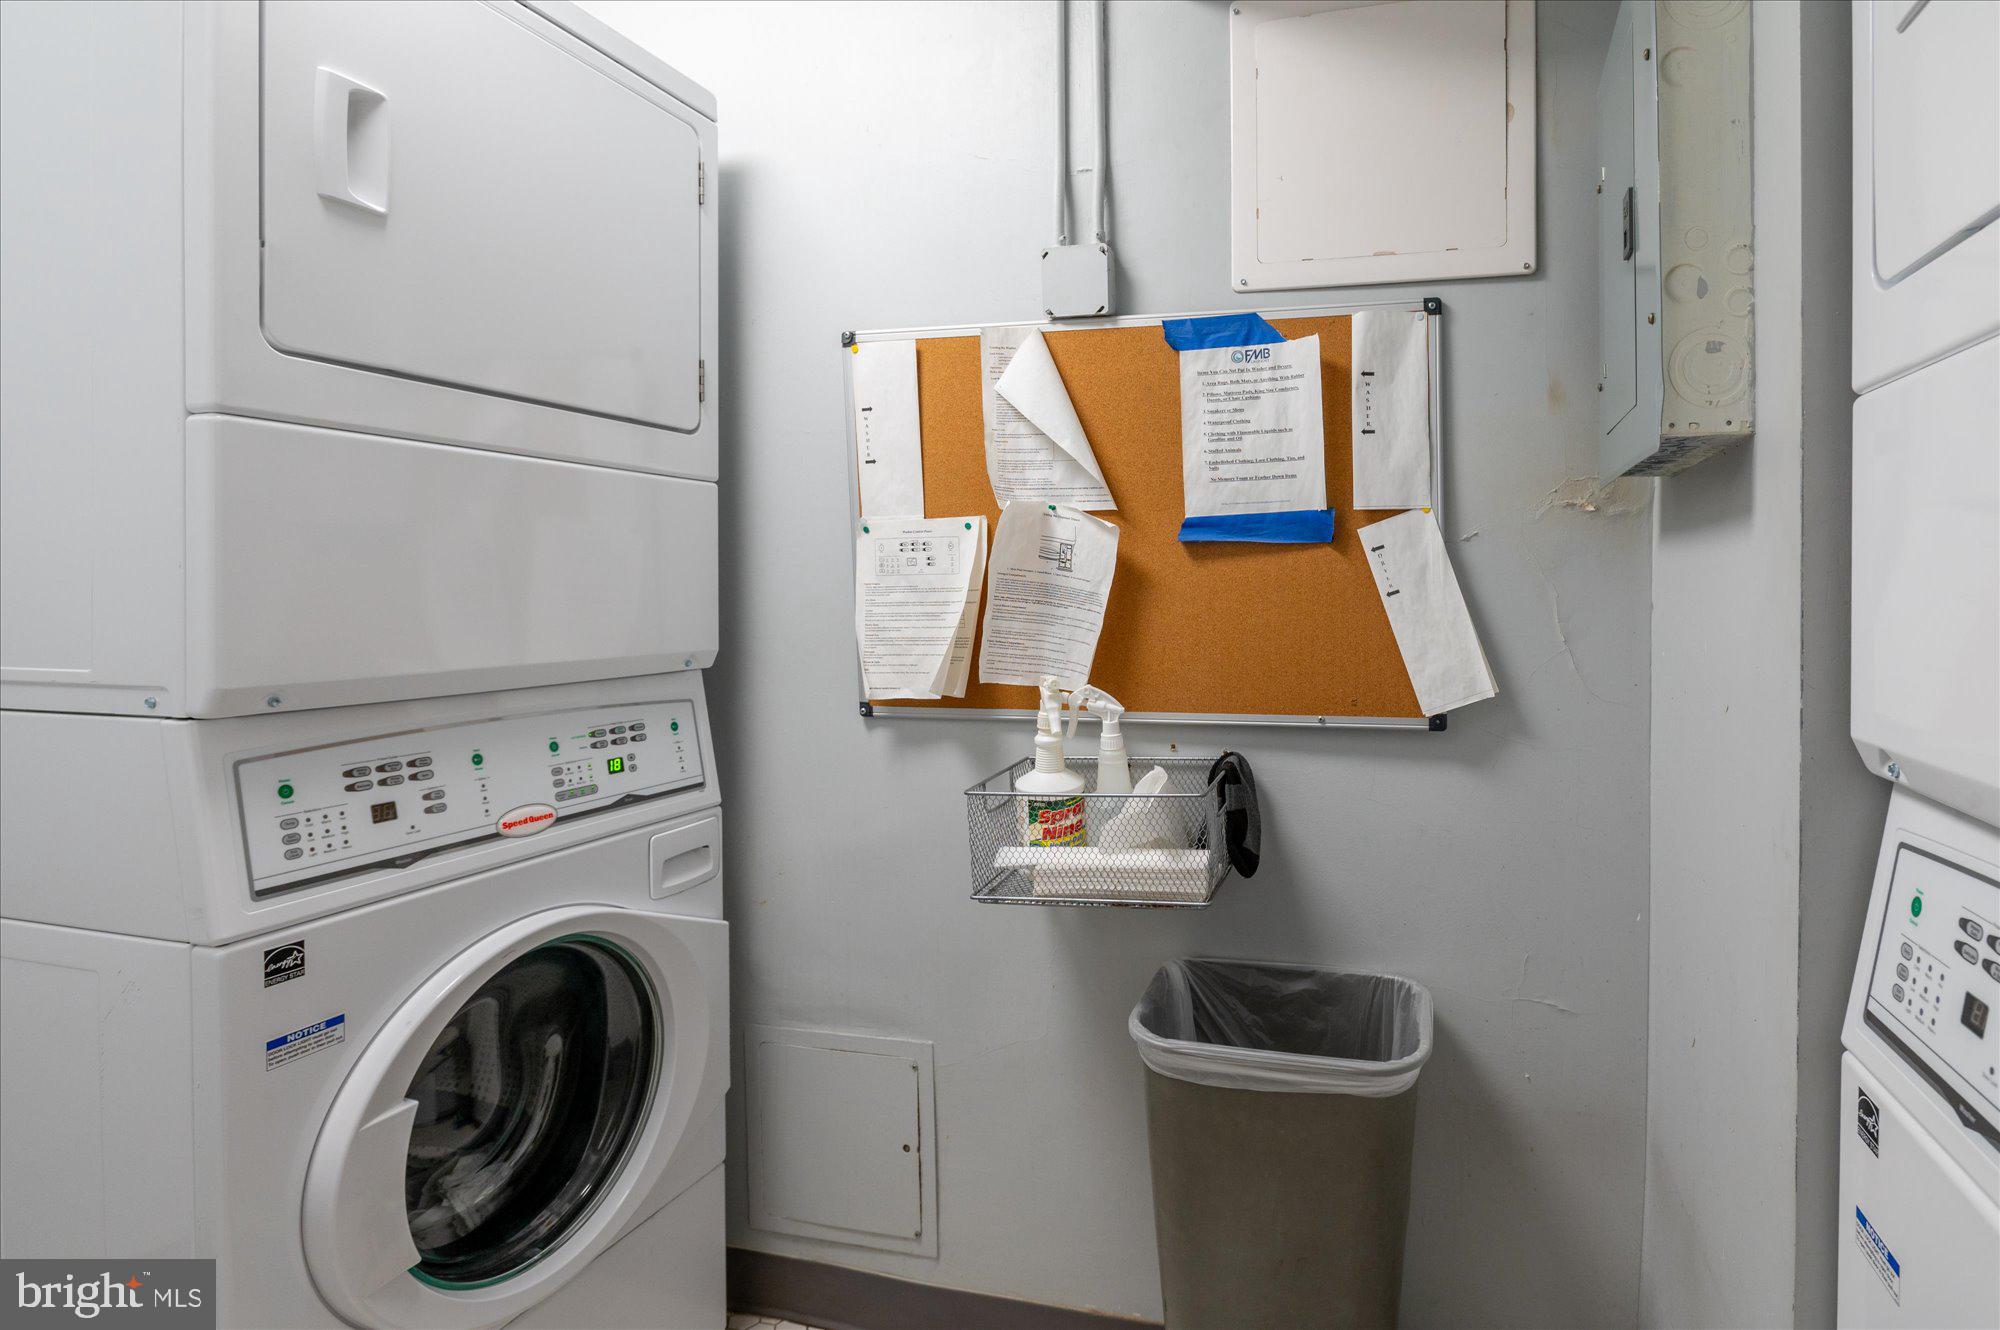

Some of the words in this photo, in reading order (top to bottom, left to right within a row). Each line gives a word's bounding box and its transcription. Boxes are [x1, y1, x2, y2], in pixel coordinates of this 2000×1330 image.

[1245, 348, 1270, 363] FMB
[610, 758, 621, 772] 18
[502, 817, 528, 830] Speed
[529, 812, 554, 823] Queen
[1042, 819, 1082, 840] Nine
[264, 975, 288, 986] ENERGY
[287, 1022, 326, 1042] NOTICE
[268, 1047, 282, 1056] DOOR
[298, 1037, 311, 1046] LIGHT
[284, 1045, 307, 1056] attempting
[288, 1052, 299, 1060] push
[1866, 1221, 1889, 1260] NOTICE
